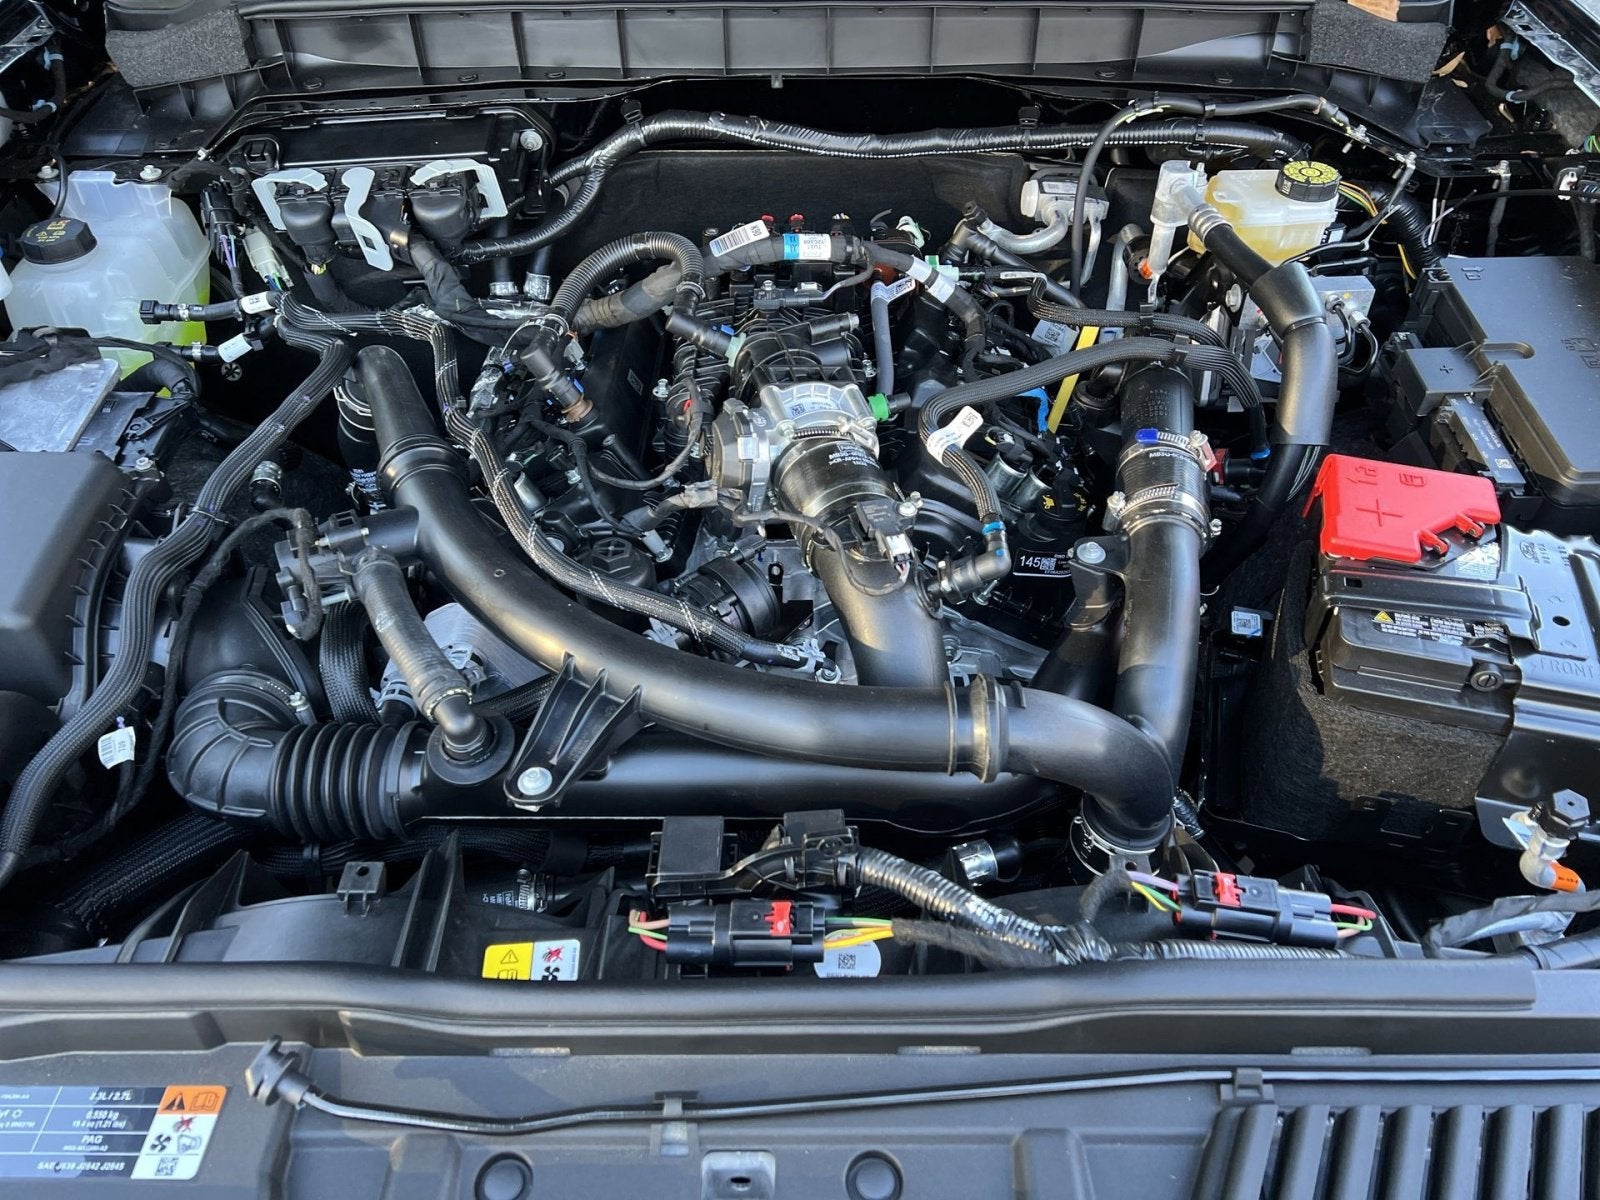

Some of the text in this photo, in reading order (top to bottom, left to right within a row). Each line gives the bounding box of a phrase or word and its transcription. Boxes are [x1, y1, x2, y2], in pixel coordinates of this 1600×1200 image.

[1020, 555, 1041, 568] 145
[1540, 657, 1594, 679] FRONT
[81, 1135, 103, 1144] PAG
[38, 1161, 55, 1170] SAE
